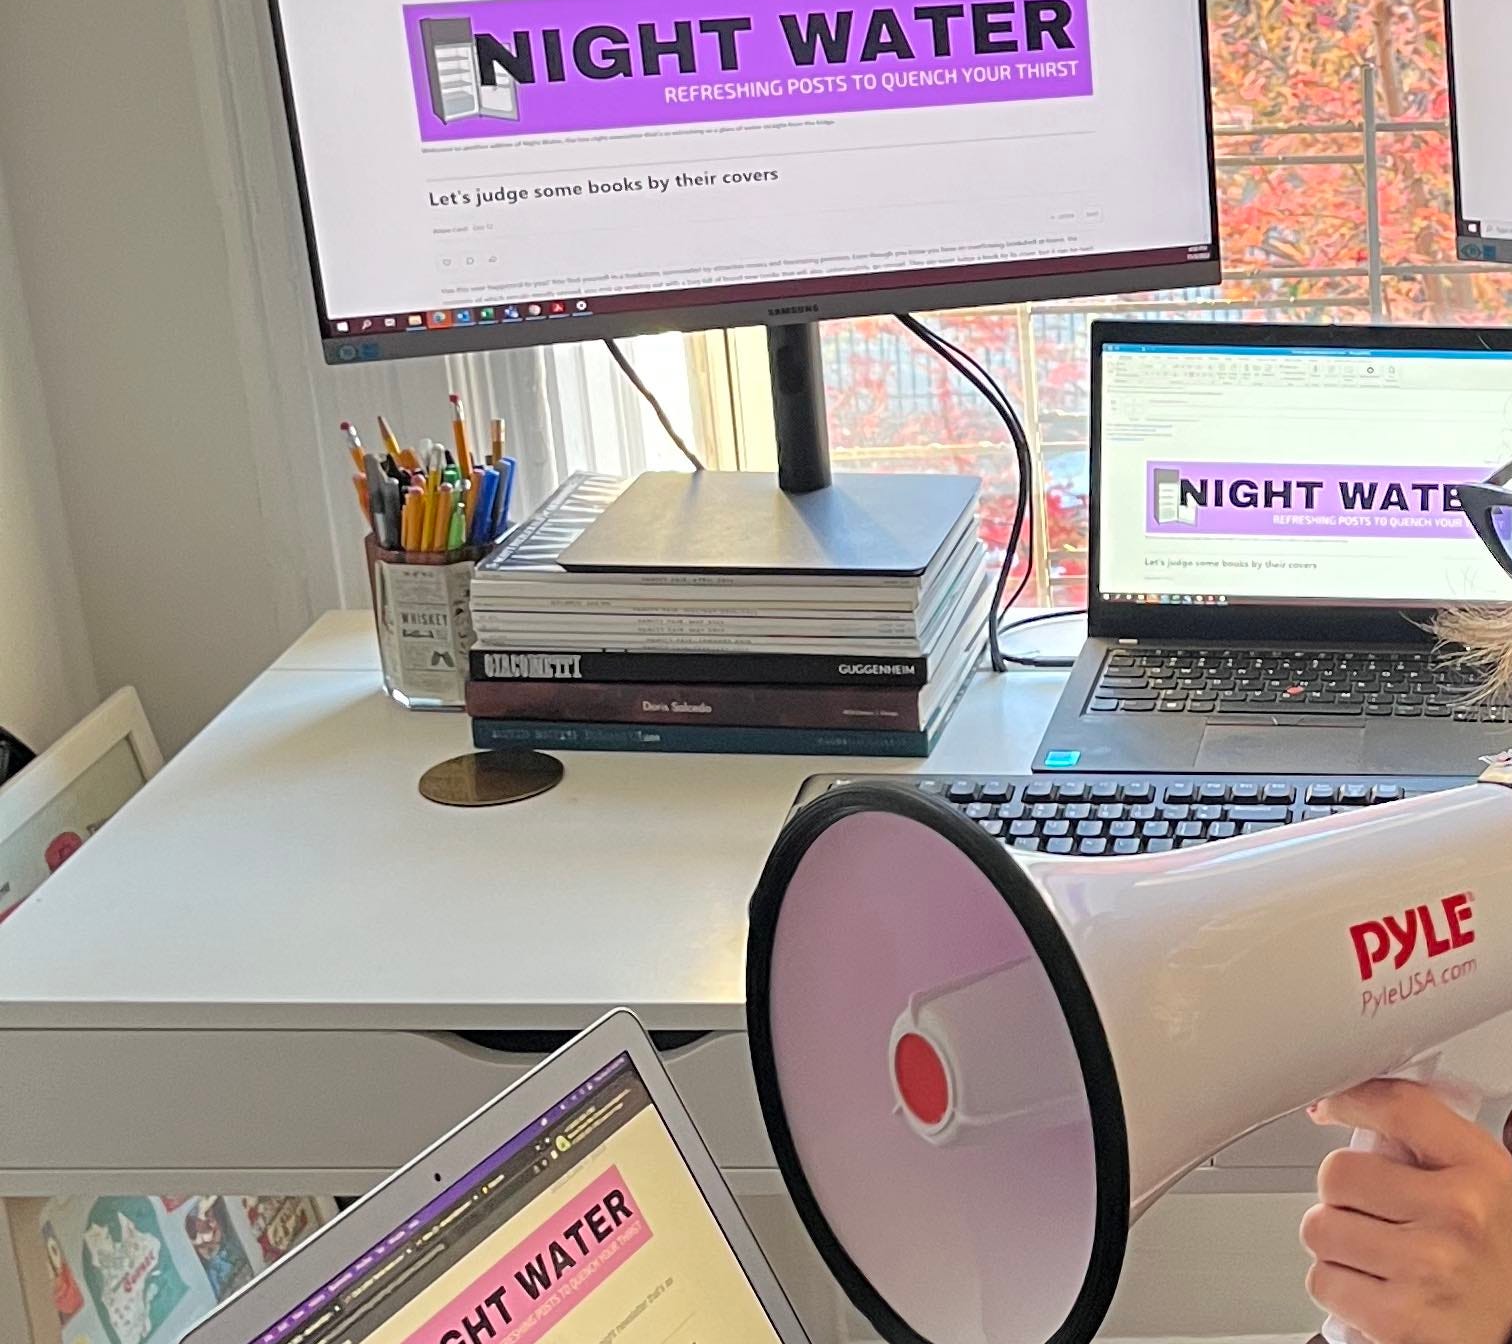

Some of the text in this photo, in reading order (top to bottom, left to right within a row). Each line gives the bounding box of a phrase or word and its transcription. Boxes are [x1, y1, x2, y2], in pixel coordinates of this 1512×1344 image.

[474, 0, 1076, 86] NIGHT WATER
[663, 60, 1079, 104] REFRESHING POSTS TO QUENCH YOUR THIRST
[429, 167, 779, 208] Let's judge some books by their covers
[768, 303, 820, 316] SAMSUNG
[1180, 479, 1466, 512] NIGHT WATE
[1273, 514, 1462, 529] REFRESHING POSTS TO QUENCH YOUR
[1144, 558, 1165, 568] Let's
[1167, 559, 1194, 570] judge
[1222, 559, 1249, 568] books
[1251, 559, 1262, 570] by
[1264, 560, 1286, 568] their
[1288, 561, 1318, 569] covers
[401, 612, 448, 626] WHISKEY
[484, 654, 916, 680] GIACOMETTI GUGGENHEIM
[642, 701, 713, 714] Doris Salcedo
[1350, 892, 1475, 981] PYLE
[1361, 958, 1478, 1020] PyleUSA.com
[513, 1189, 634, 1301] WATER
